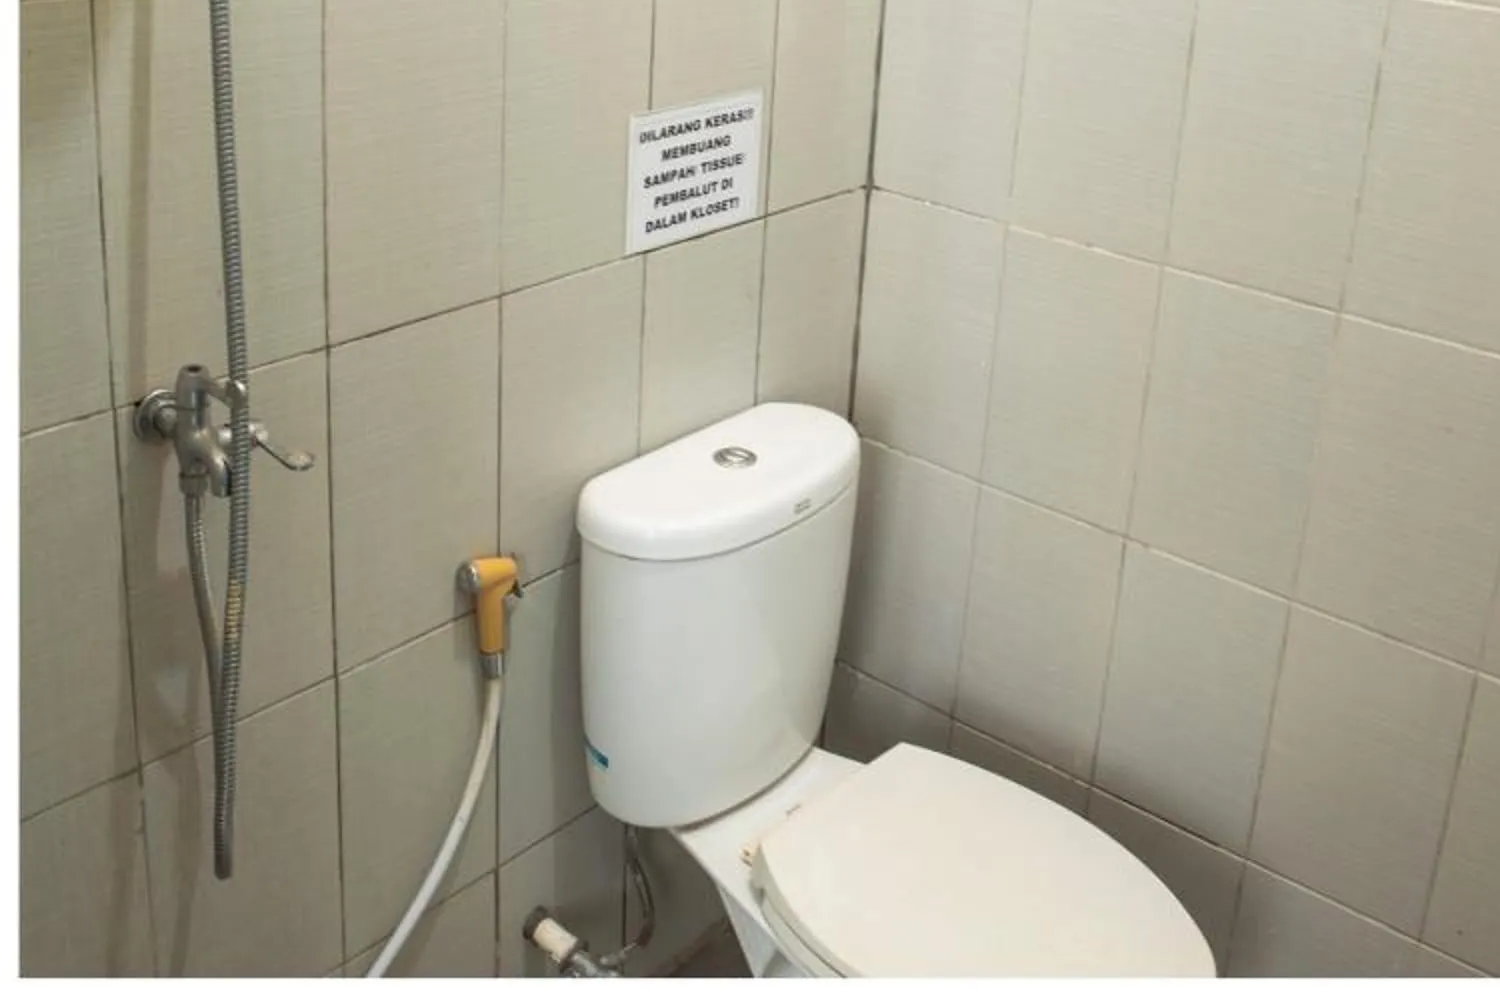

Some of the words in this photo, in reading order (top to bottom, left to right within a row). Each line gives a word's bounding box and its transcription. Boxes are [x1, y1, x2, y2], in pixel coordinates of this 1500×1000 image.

[639, 119, 702, 144] DILARANG
[661, 135, 732, 161] MEMBUANG
[654, 181, 718, 209] PEMBALUT
[721, 177, 733, 190] DI
[645, 211, 687, 233] DALAM
